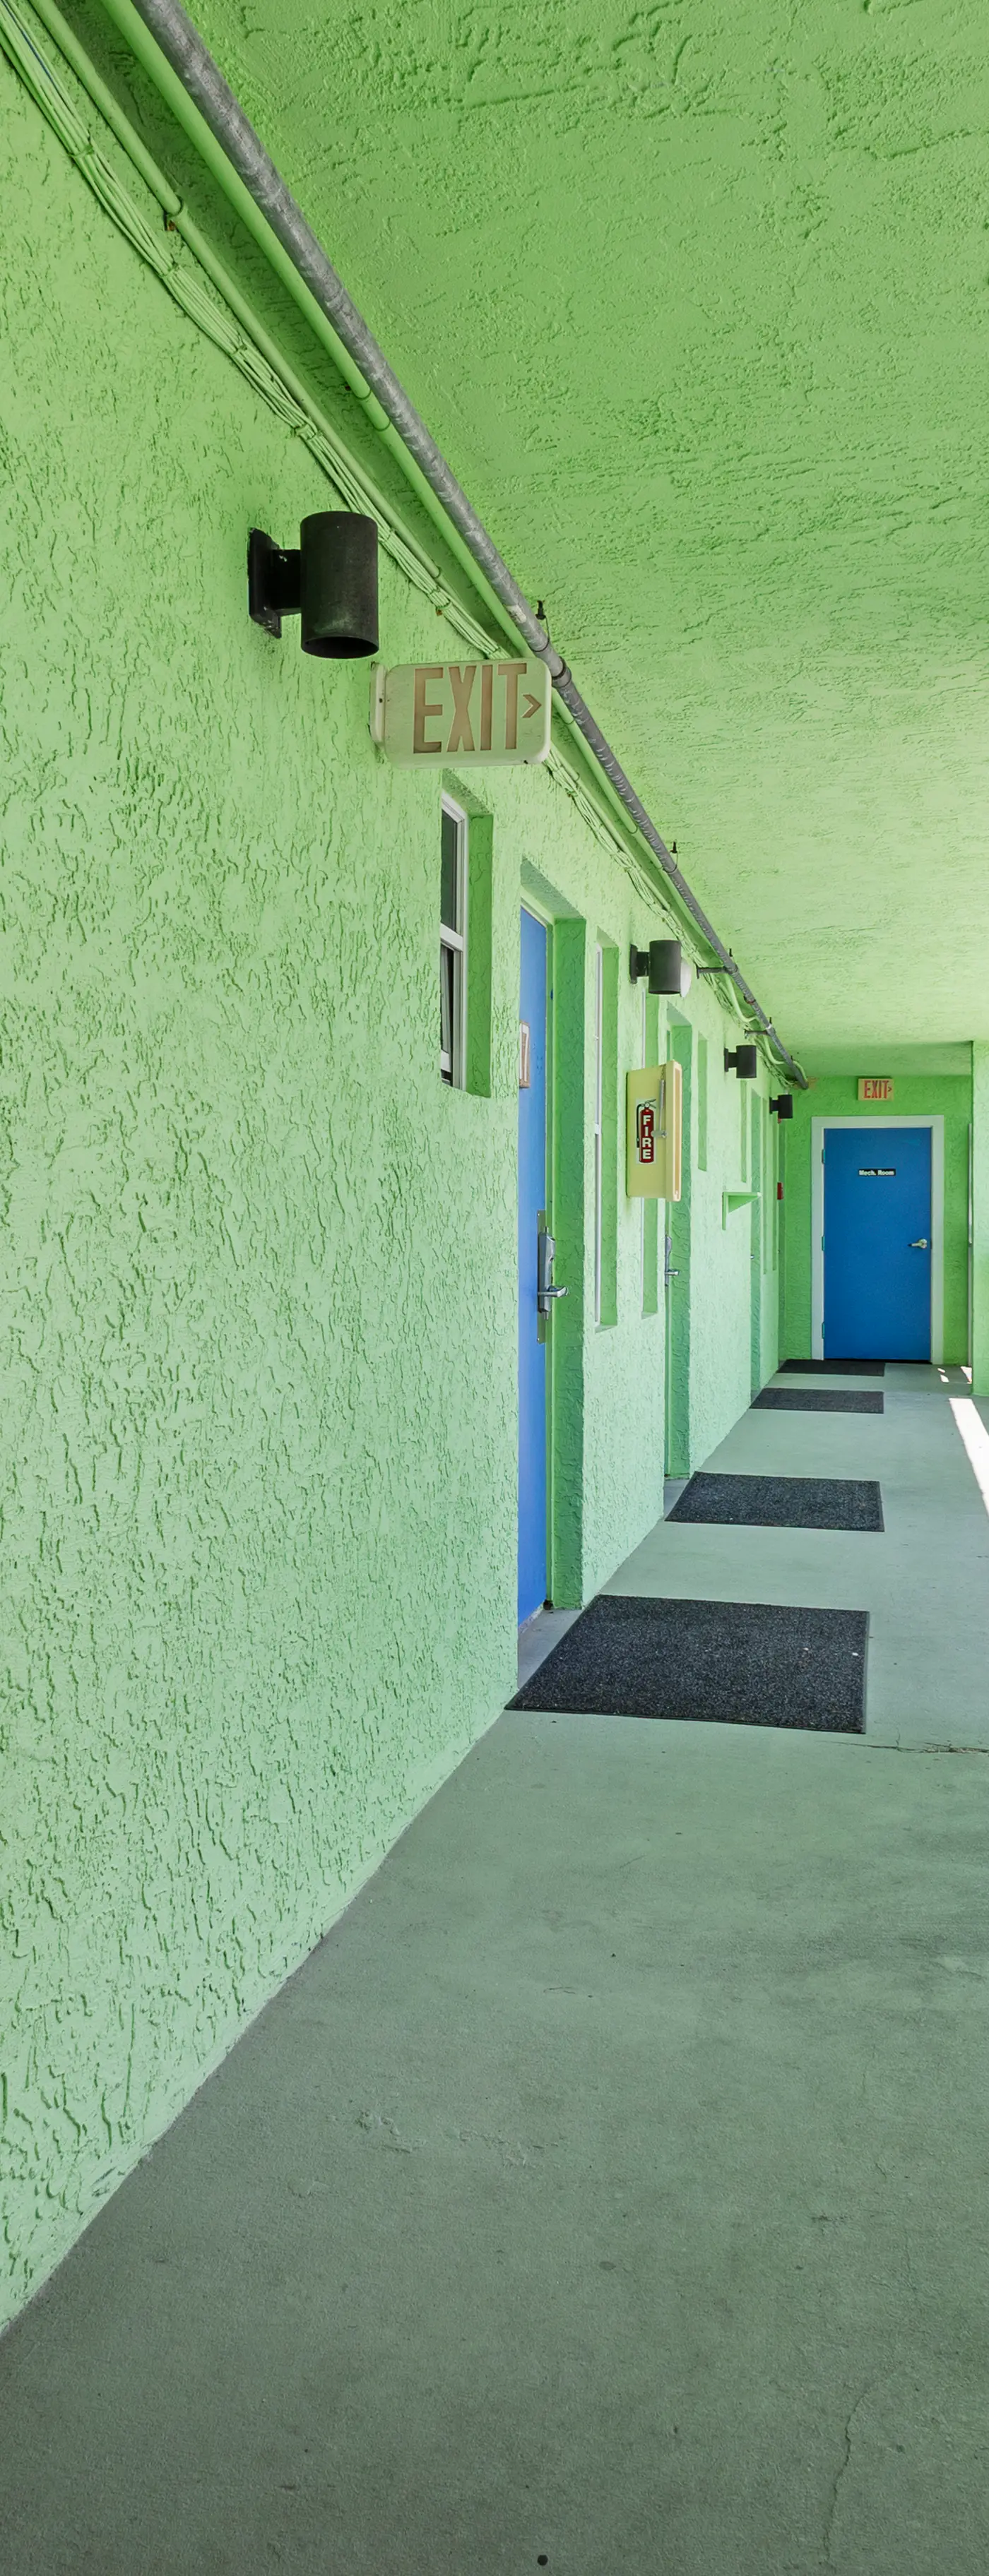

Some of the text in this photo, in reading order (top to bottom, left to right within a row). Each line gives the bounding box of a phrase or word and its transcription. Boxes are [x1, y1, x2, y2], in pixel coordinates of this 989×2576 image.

[413, 662, 527, 753] EXIT
[864, 1080, 889, 1099] EXIT
[642, 1115, 651, 1159] FIRE
